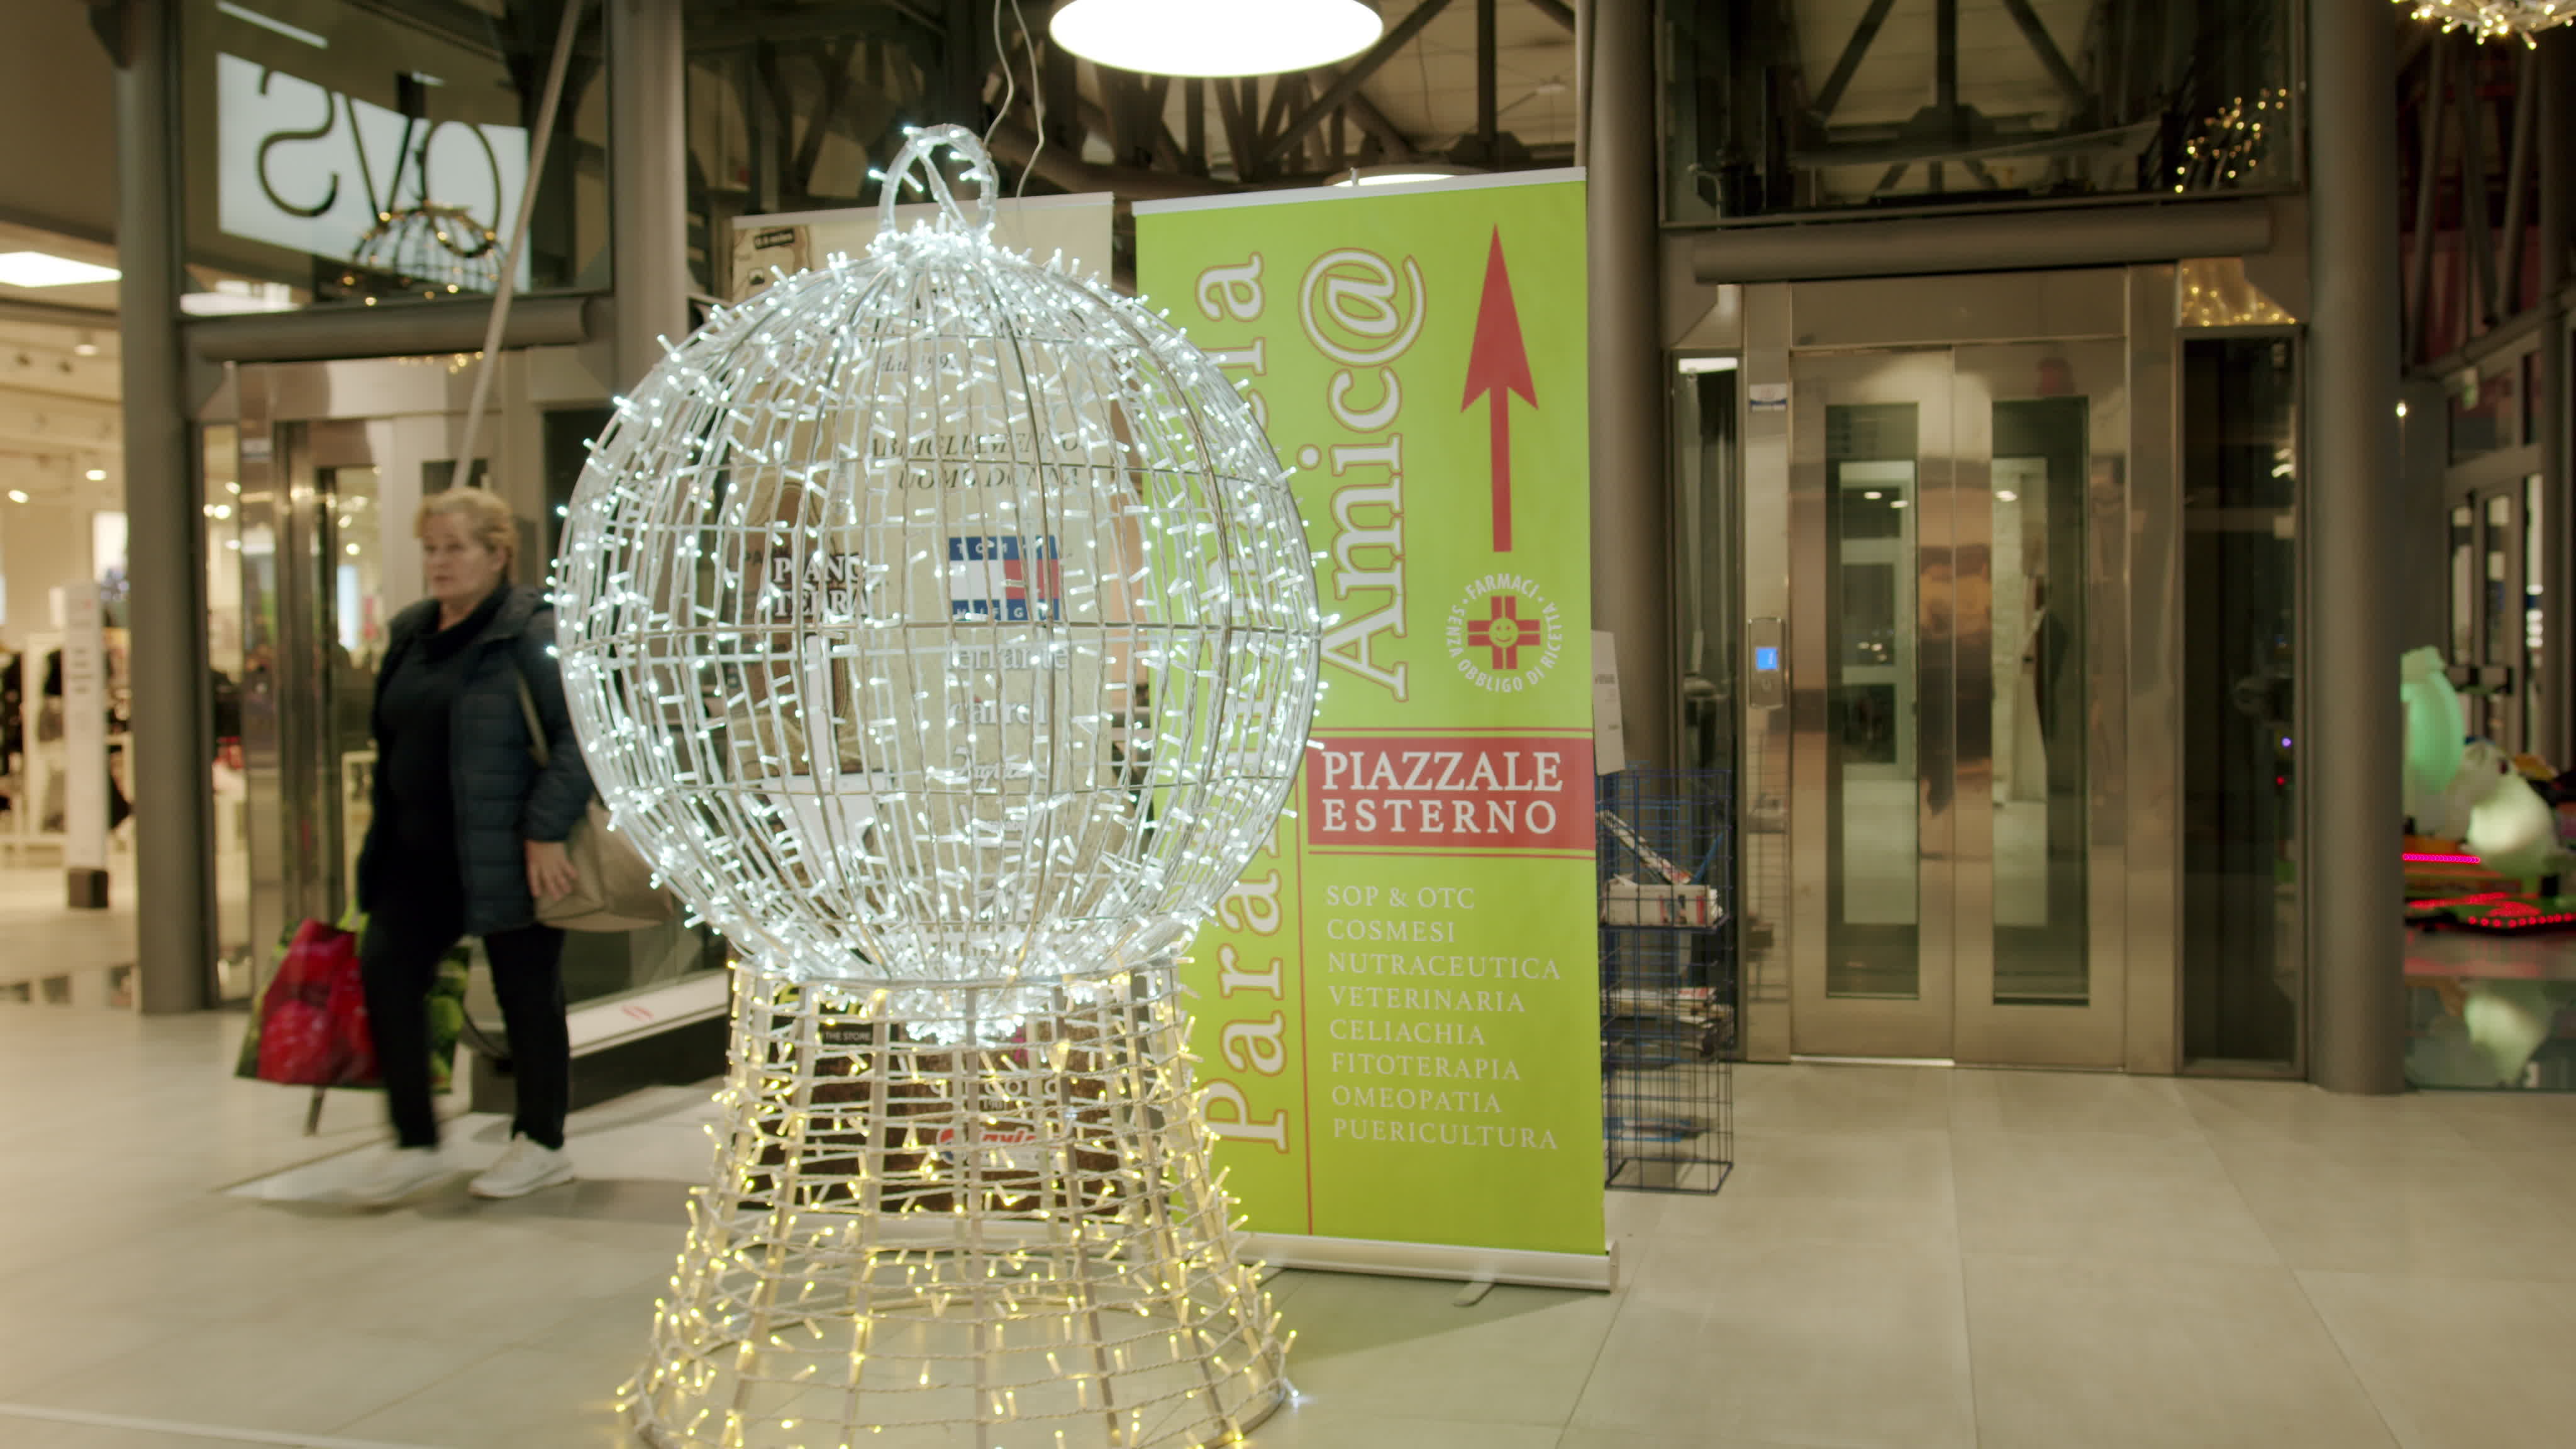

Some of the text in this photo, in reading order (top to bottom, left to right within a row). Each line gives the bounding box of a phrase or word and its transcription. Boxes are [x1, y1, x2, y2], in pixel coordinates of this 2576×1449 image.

[1464, 573, 1540, 599] FARMACI
[1446, 602, 1563, 693] SENZA OBBLIGO DI RICETTA
[1321, 750, 1563, 792] PIAZZALE
[1322, 798, 1557, 834] ESTERNO
[1326, 885, 1475, 909] SOP & OTC
[1326, 919, 1455, 943] COSMESI
[1328, 952, 1560, 980] NUTRACEUTICA
[1328, 985, 1525, 1013] VETERINARIA
[1329, 1019, 1487, 1046] CELIACHIA
[1331, 1052, 1521, 1081] FITOTERAPIA
[1332, 1085, 1502, 1114] OMEOPATIA
[1333, 1118, 1558, 1150] PUERICULTURA
